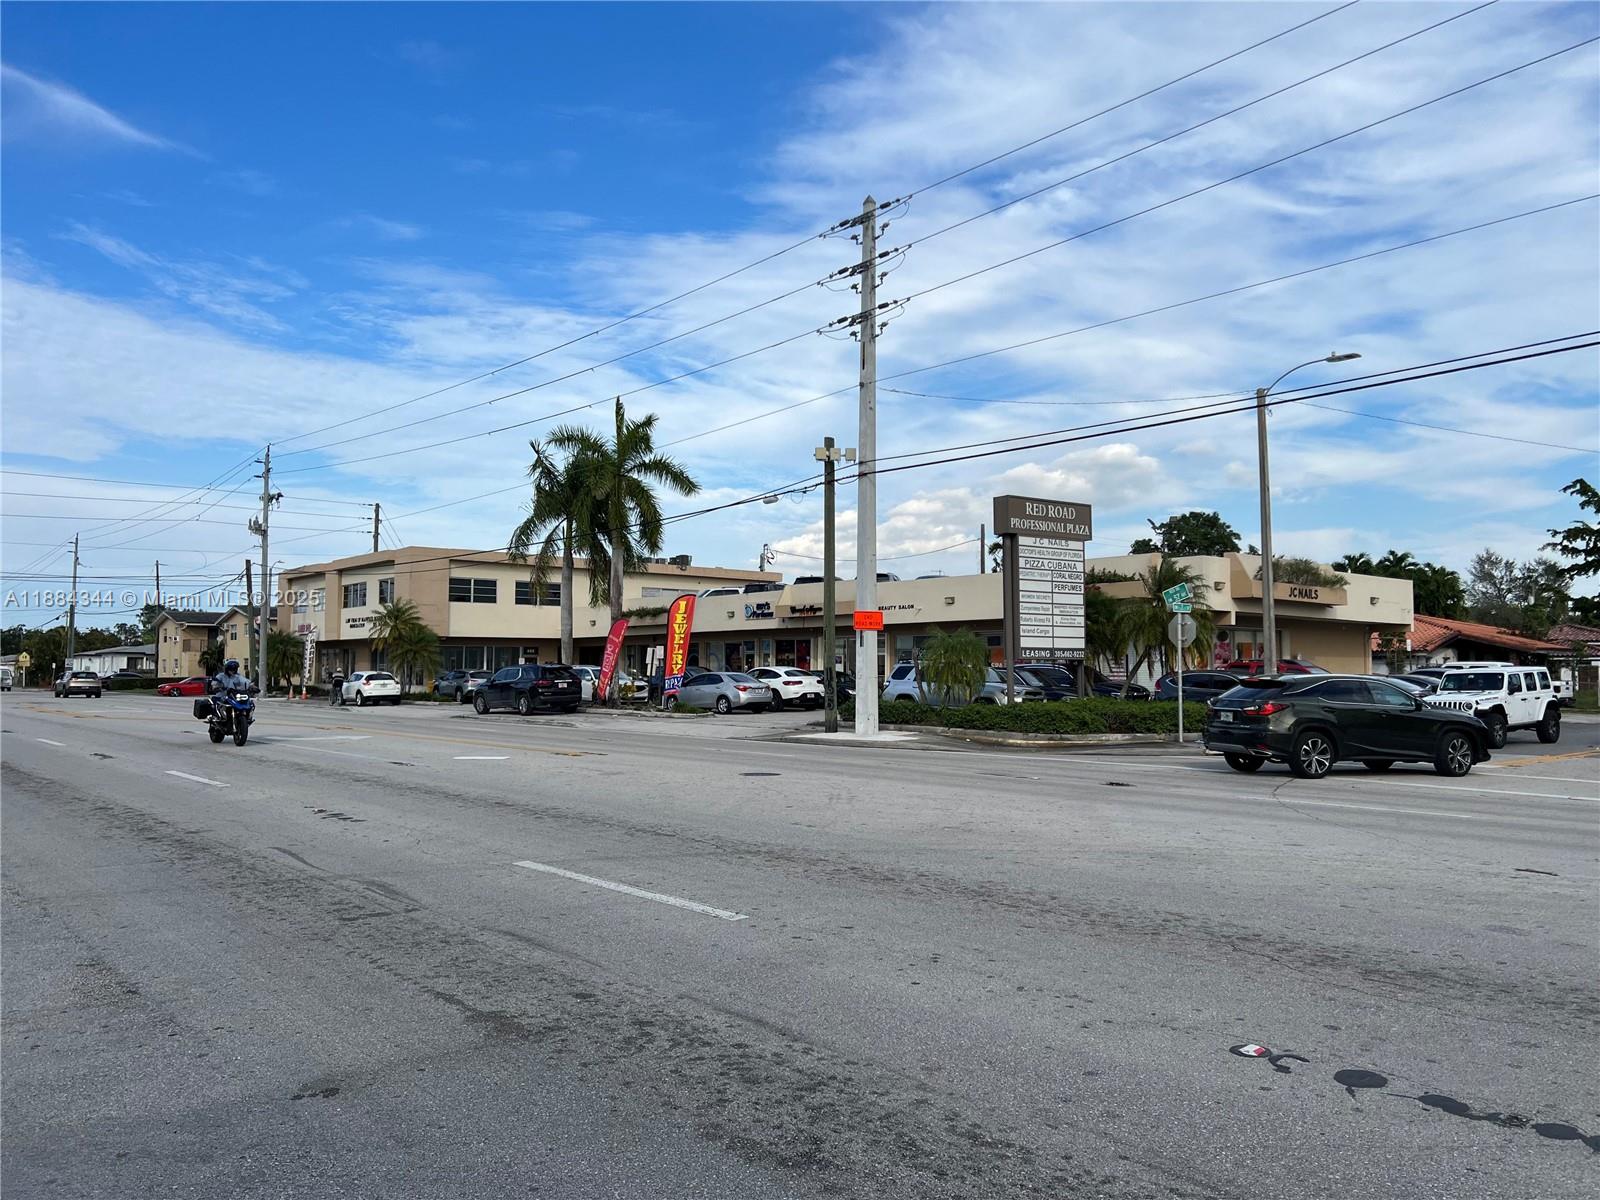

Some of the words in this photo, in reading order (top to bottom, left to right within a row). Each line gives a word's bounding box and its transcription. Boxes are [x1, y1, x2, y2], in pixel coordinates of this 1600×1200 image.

[1026, 502, 1046, 516] RED
[1048, 505, 1076, 520] ROAD
[1011, 517, 1066, 533] PROFESSIONAL
[1067, 523, 1090, 535] PLAZA
[1048, 539, 1070, 548] NAILS
[1024, 559, 1047, 569] PIZZA
[1047, 562, 1078, 571] CUBANA
[1053, 572, 1068, 580] CORAL
[1068, 573, 1082, 581] NEGRO
[1054, 583, 1082, 592] PERFUMES
[1289, 586, 1298, 598] JC
[1298, 587, 1319, 600] NAILS
[672, 600, 688, 675] JEWELRY
